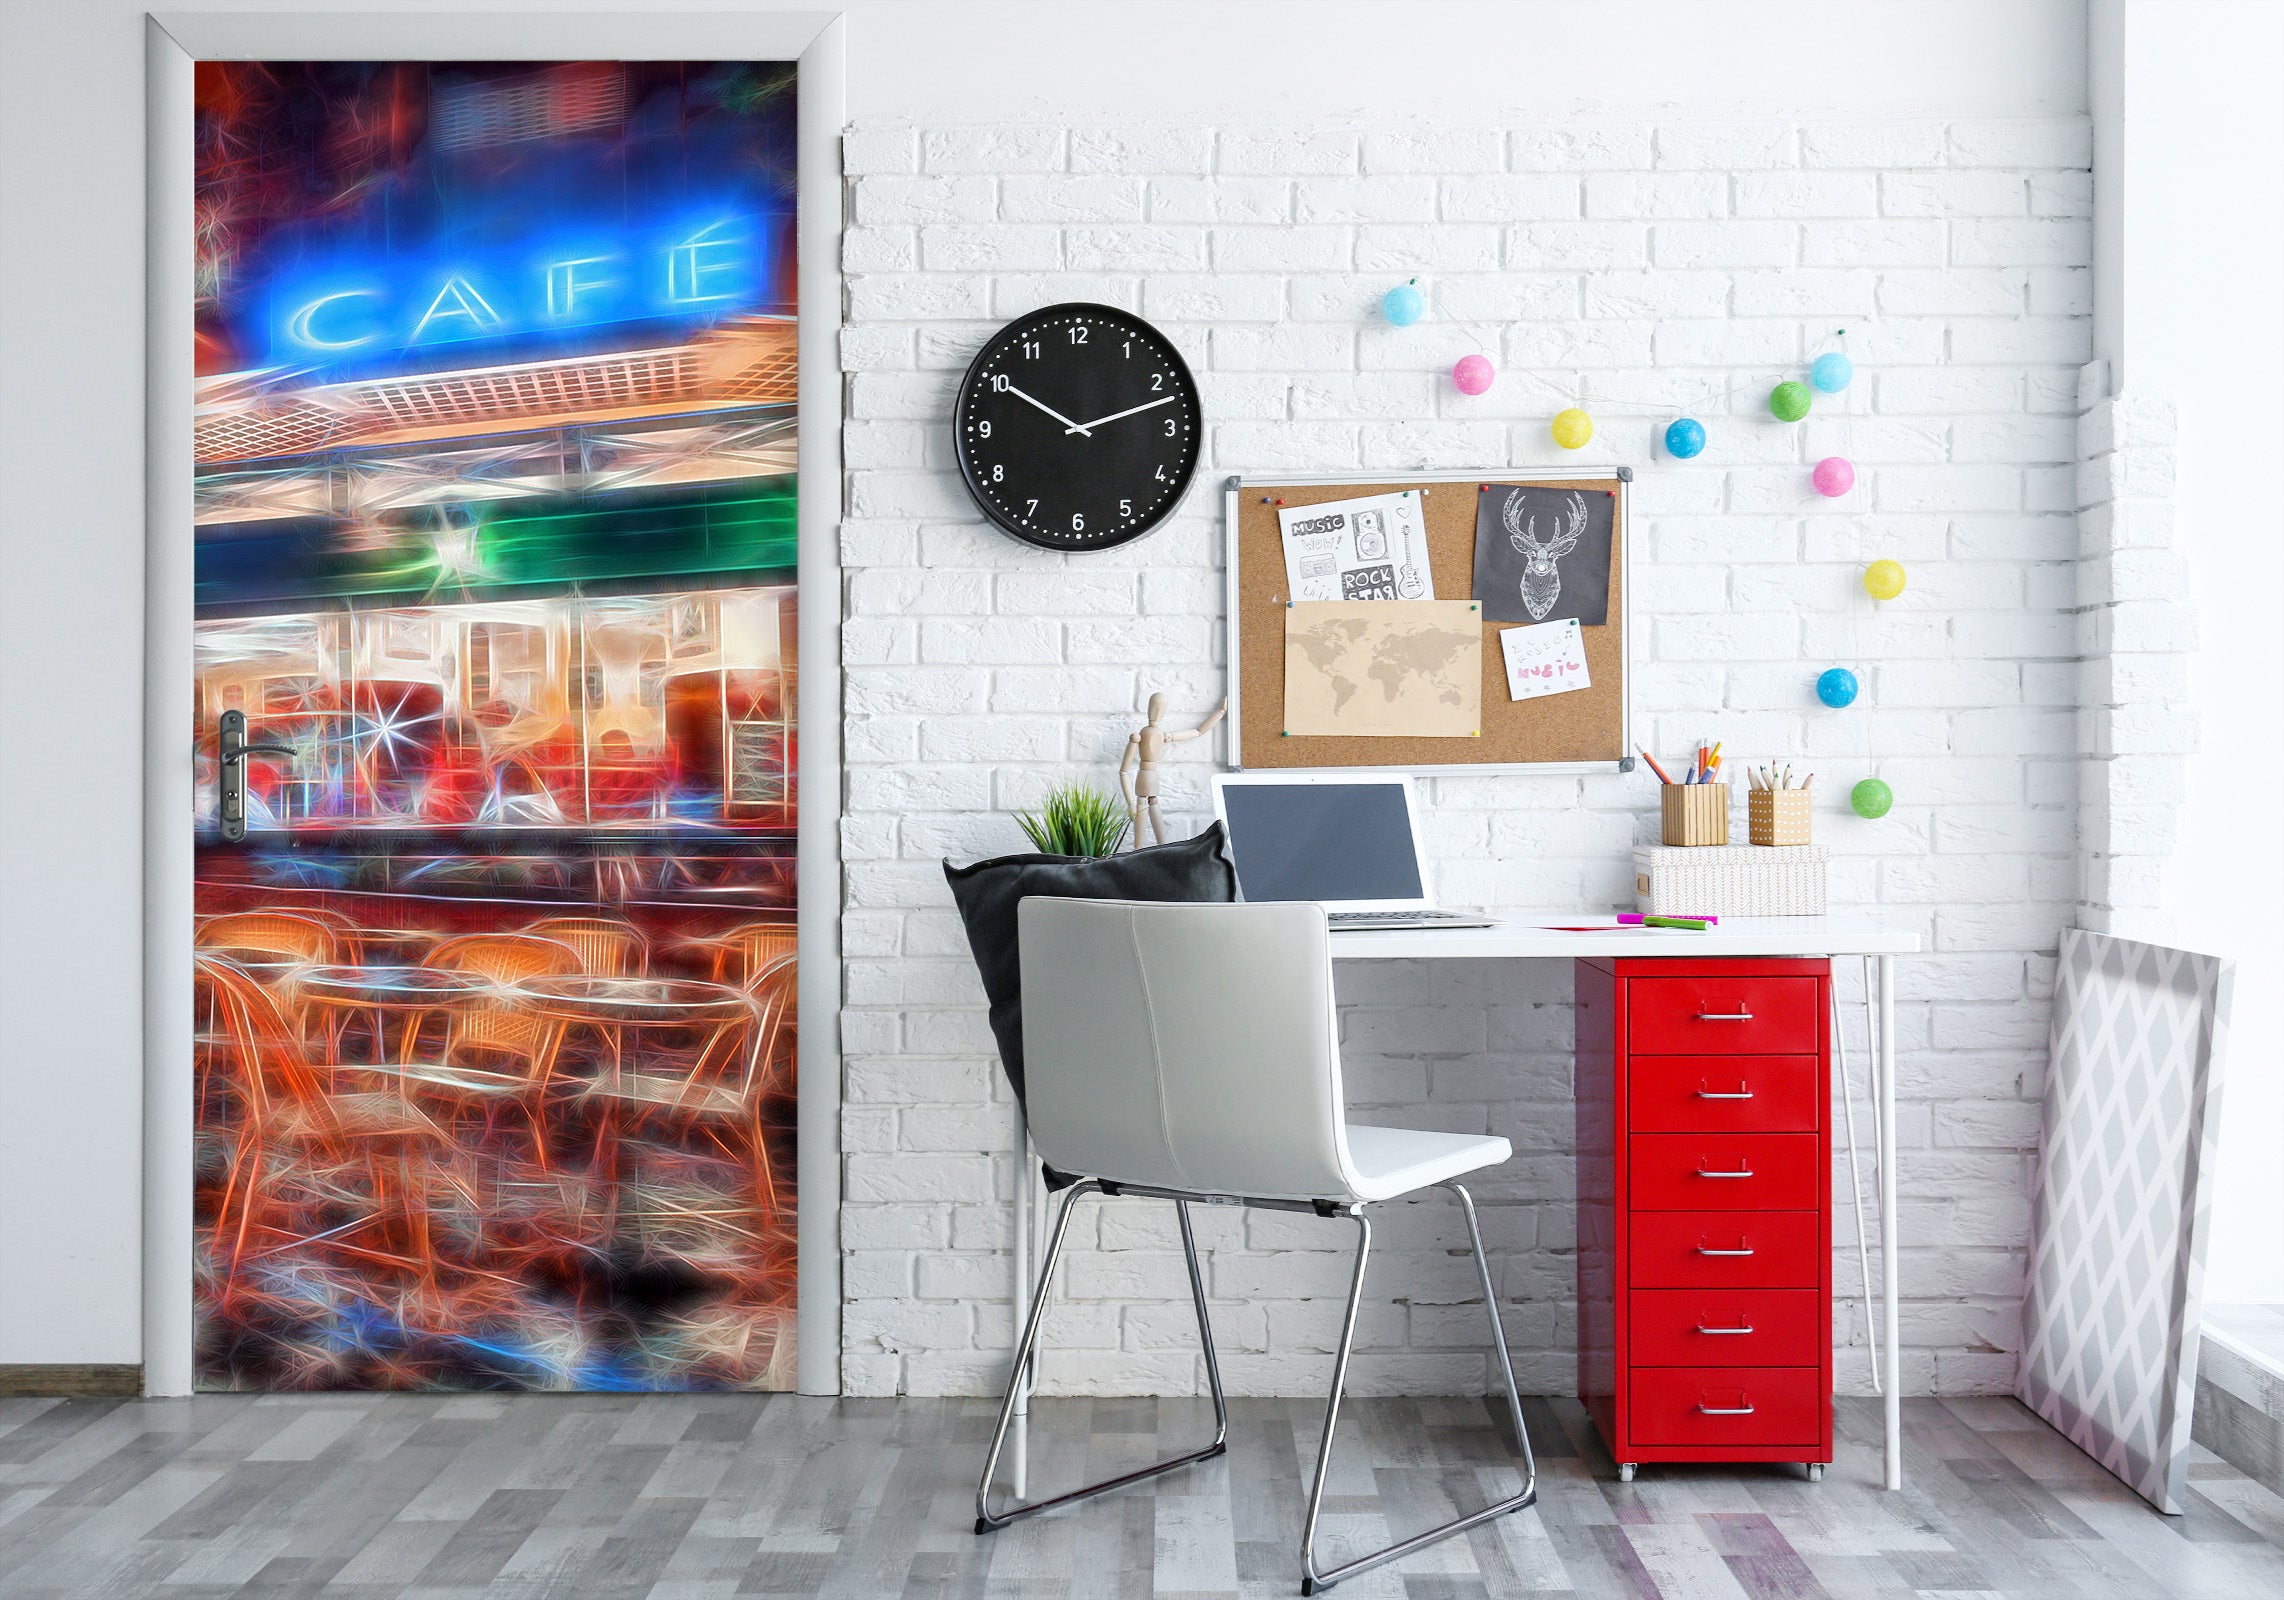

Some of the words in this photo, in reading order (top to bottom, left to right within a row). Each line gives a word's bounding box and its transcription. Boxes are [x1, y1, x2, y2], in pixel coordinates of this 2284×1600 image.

[1068, 327, 1088, 345] 12
[1023, 342, 1040, 359] 11
[1122, 342, 1130, 359] 1
[990, 374, 1010, 393] 10
[1151, 374, 1163, 391] 2
[979, 420, 991, 438] 9
[1164, 419, 1176, 437] 3
[993, 465, 1004, 482] 8
[1155, 464, 1166, 482] 4
[1026, 499, 1038, 517] 7
[1119, 499, 1131, 517] 5
[1072, 513, 1084, 531] 6
[1345, 568, 1391, 589] ROCK
